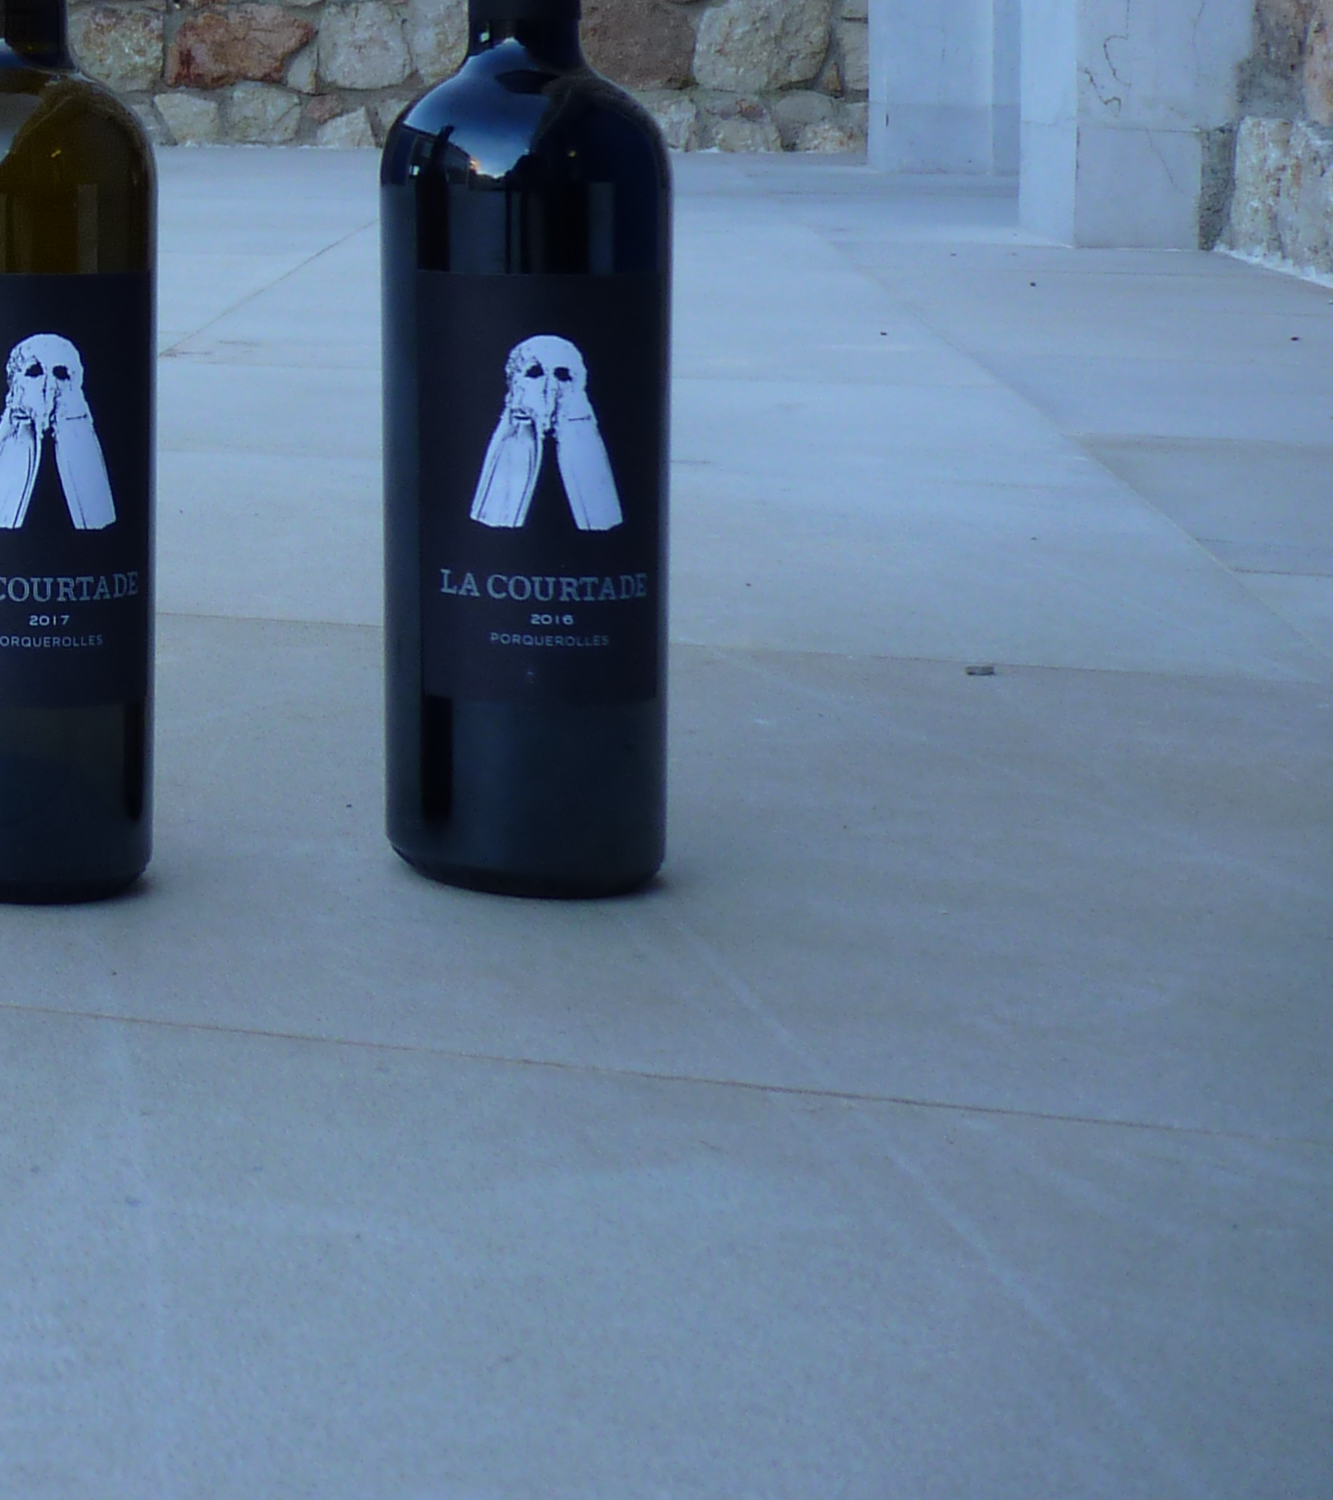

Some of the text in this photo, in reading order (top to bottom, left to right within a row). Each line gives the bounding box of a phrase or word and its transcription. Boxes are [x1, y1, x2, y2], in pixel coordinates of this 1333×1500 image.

[440, 568, 648, 601] LA COURTADE
[29, 615, 70, 626] 2017
[531, 613, 574, 625] 2016
[490, 632, 609, 647] PORQUEROLLES
